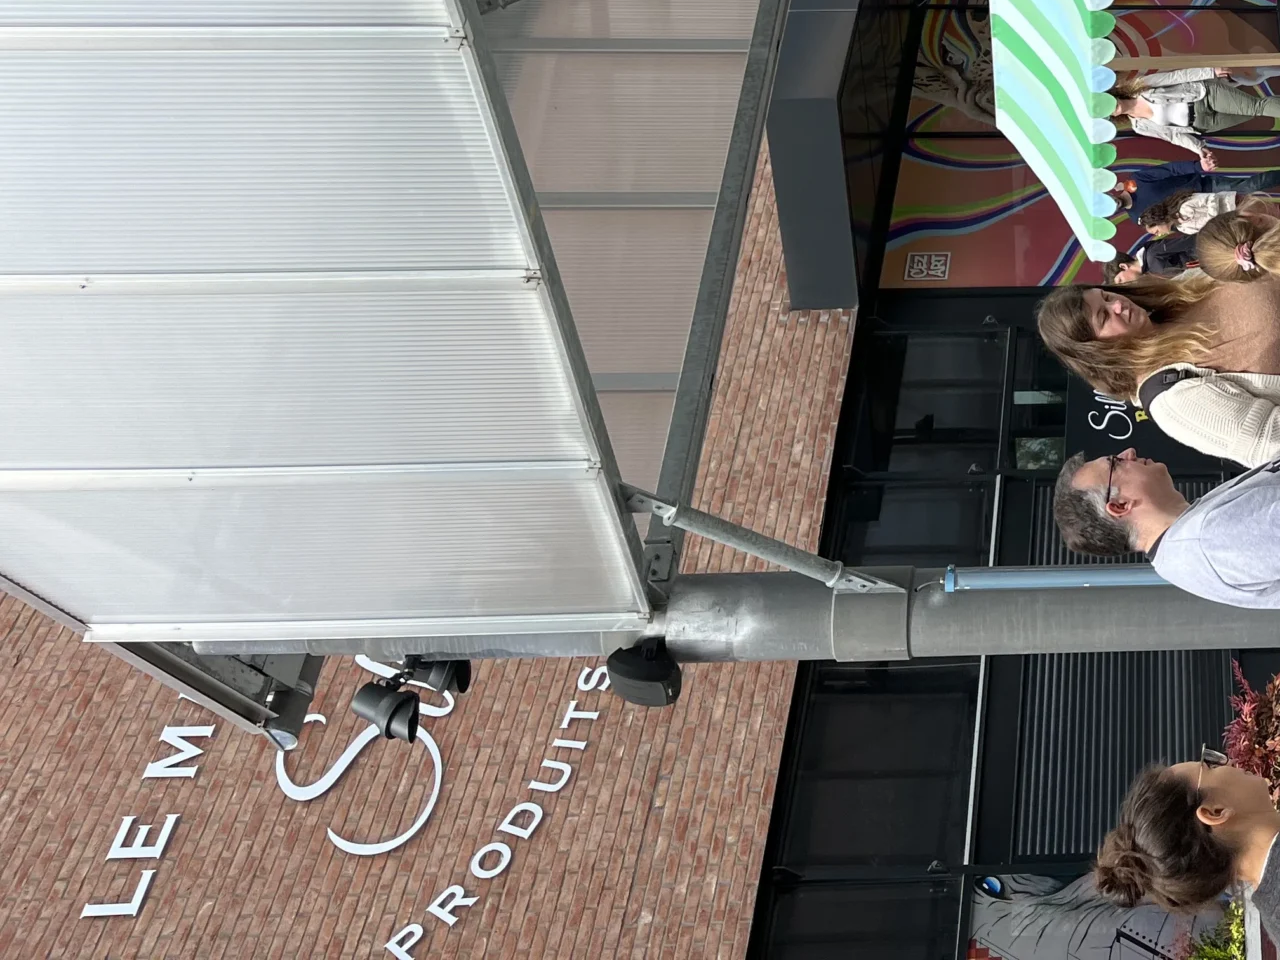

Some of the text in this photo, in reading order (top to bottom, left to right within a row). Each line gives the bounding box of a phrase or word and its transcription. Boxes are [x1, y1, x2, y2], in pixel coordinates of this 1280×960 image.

[928, 254, 946, 276] ART
[79, 693, 216, 919] LE M
[383, 665, 611, 960] PRODUITS
